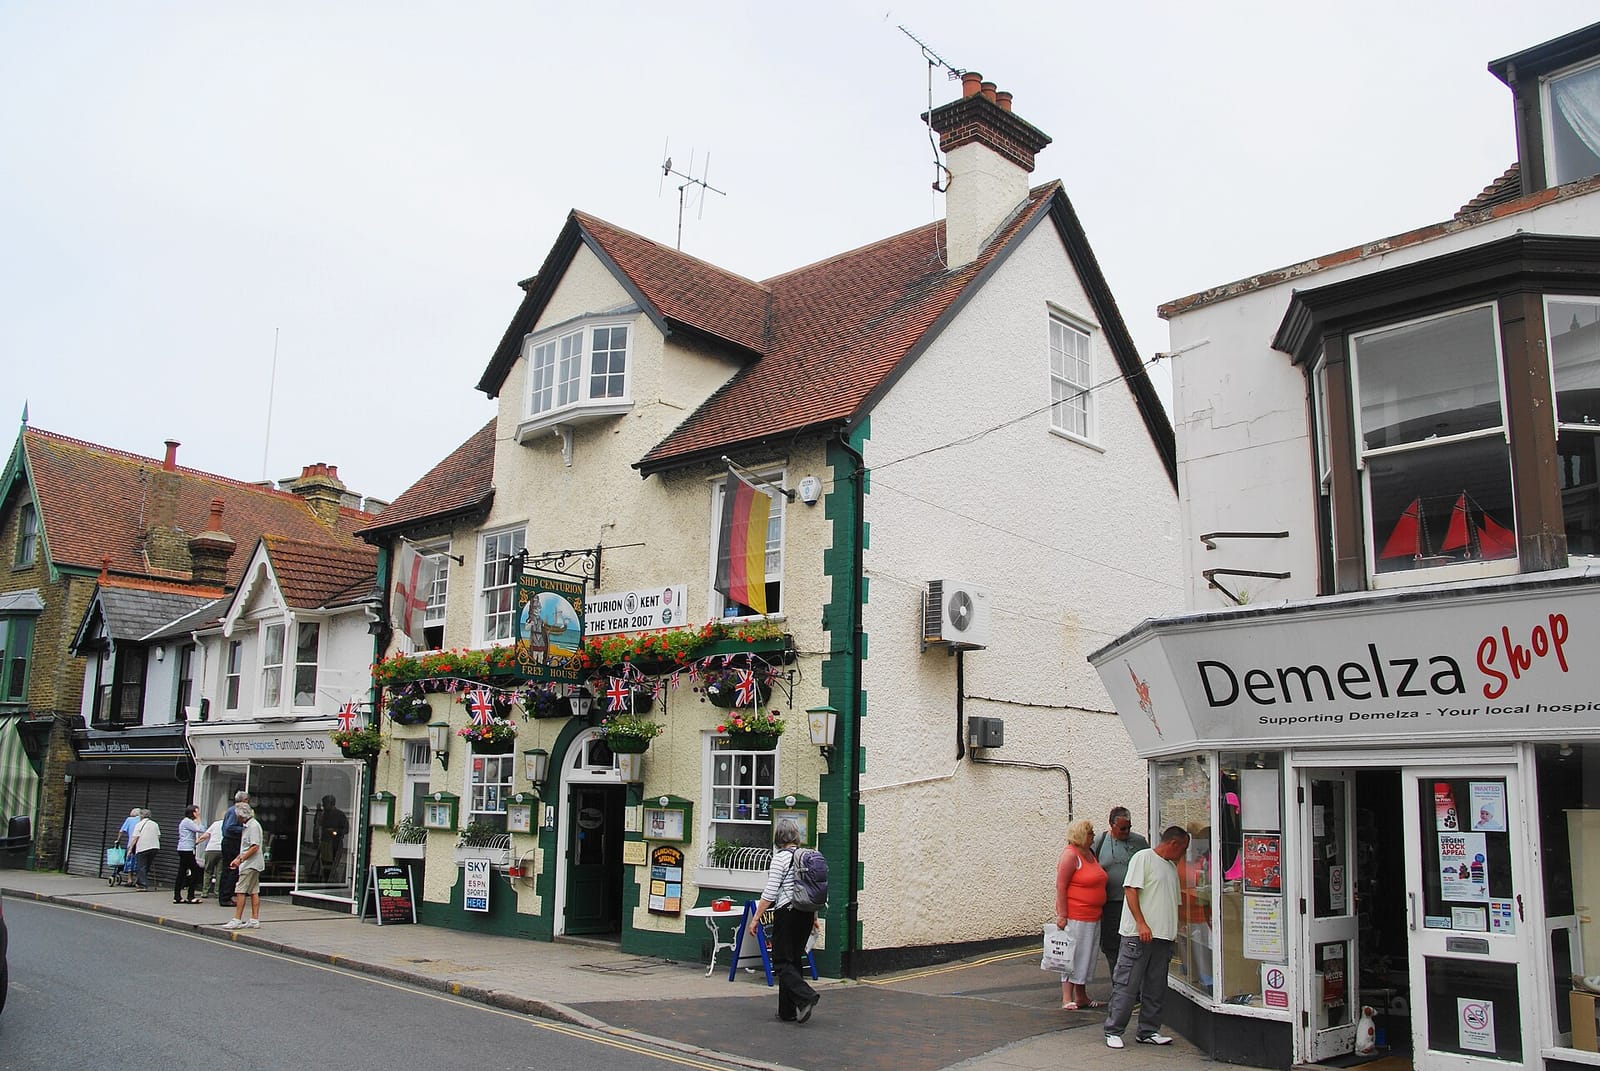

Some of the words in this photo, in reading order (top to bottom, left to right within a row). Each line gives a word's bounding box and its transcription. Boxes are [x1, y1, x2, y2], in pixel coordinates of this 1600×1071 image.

[520, 576, 539, 587] SHIP
[540, 580, 583, 594] CENTURION
[640, 595, 660, 608] KENT
[591, 620, 605, 631] THE
[608, 617, 629, 630] YEAR
[631, 615, 653, 627] 2007
[1196, 643, 1467, 707] Demelza
[1476, 613, 1569, 699] Shop
[521, 666, 544, 676] FREE
[550, 668, 578, 680] HOUSE
[1258, 713, 1344, 725] Supporting
[1349, 710, 1419, 721] Demelza
[1437, 707, 1480, 717] Your
[1485, 704, 1530, 715] local
[228, 739, 250, 753] Pilgrims
[250, 740, 275, 752] Hospices
[275, 738, 305, 750] Furniture
[305, 737, 325, 752] Shop
[467, 861, 487, 872] SKY
[468, 880, 486, 888] ESPN
[466, 888, 487, 897] SPORTS
[467, 898, 486, 909] HERE
